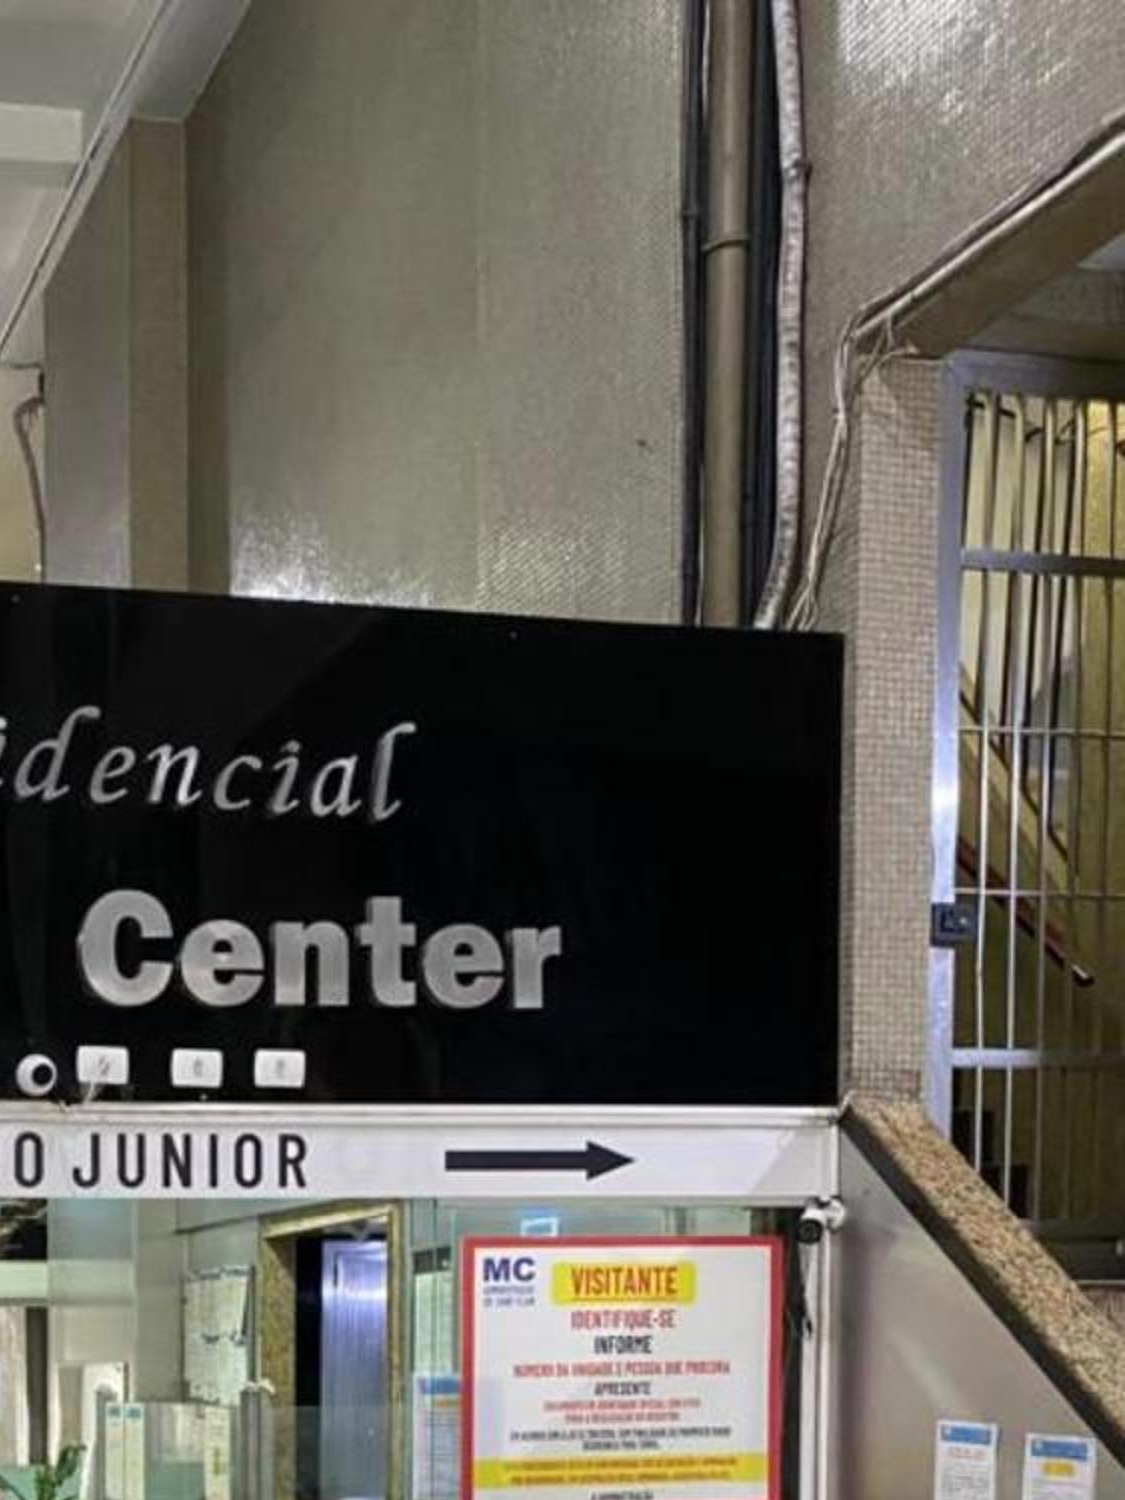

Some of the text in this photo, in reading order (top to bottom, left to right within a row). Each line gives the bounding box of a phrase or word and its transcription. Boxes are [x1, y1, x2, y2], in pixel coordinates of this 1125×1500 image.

[77, 889, 561, 1008] Center
[73, 1131, 308, 1189] JUNIOR
[483, 1257, 535, 1282] MC
[571, 1265, 677, 1296] VISITANTE
[571, 1309, 676, 1330] IDENTIFIQUE-SE
[594, 1335, 652, 1354] INFORME
